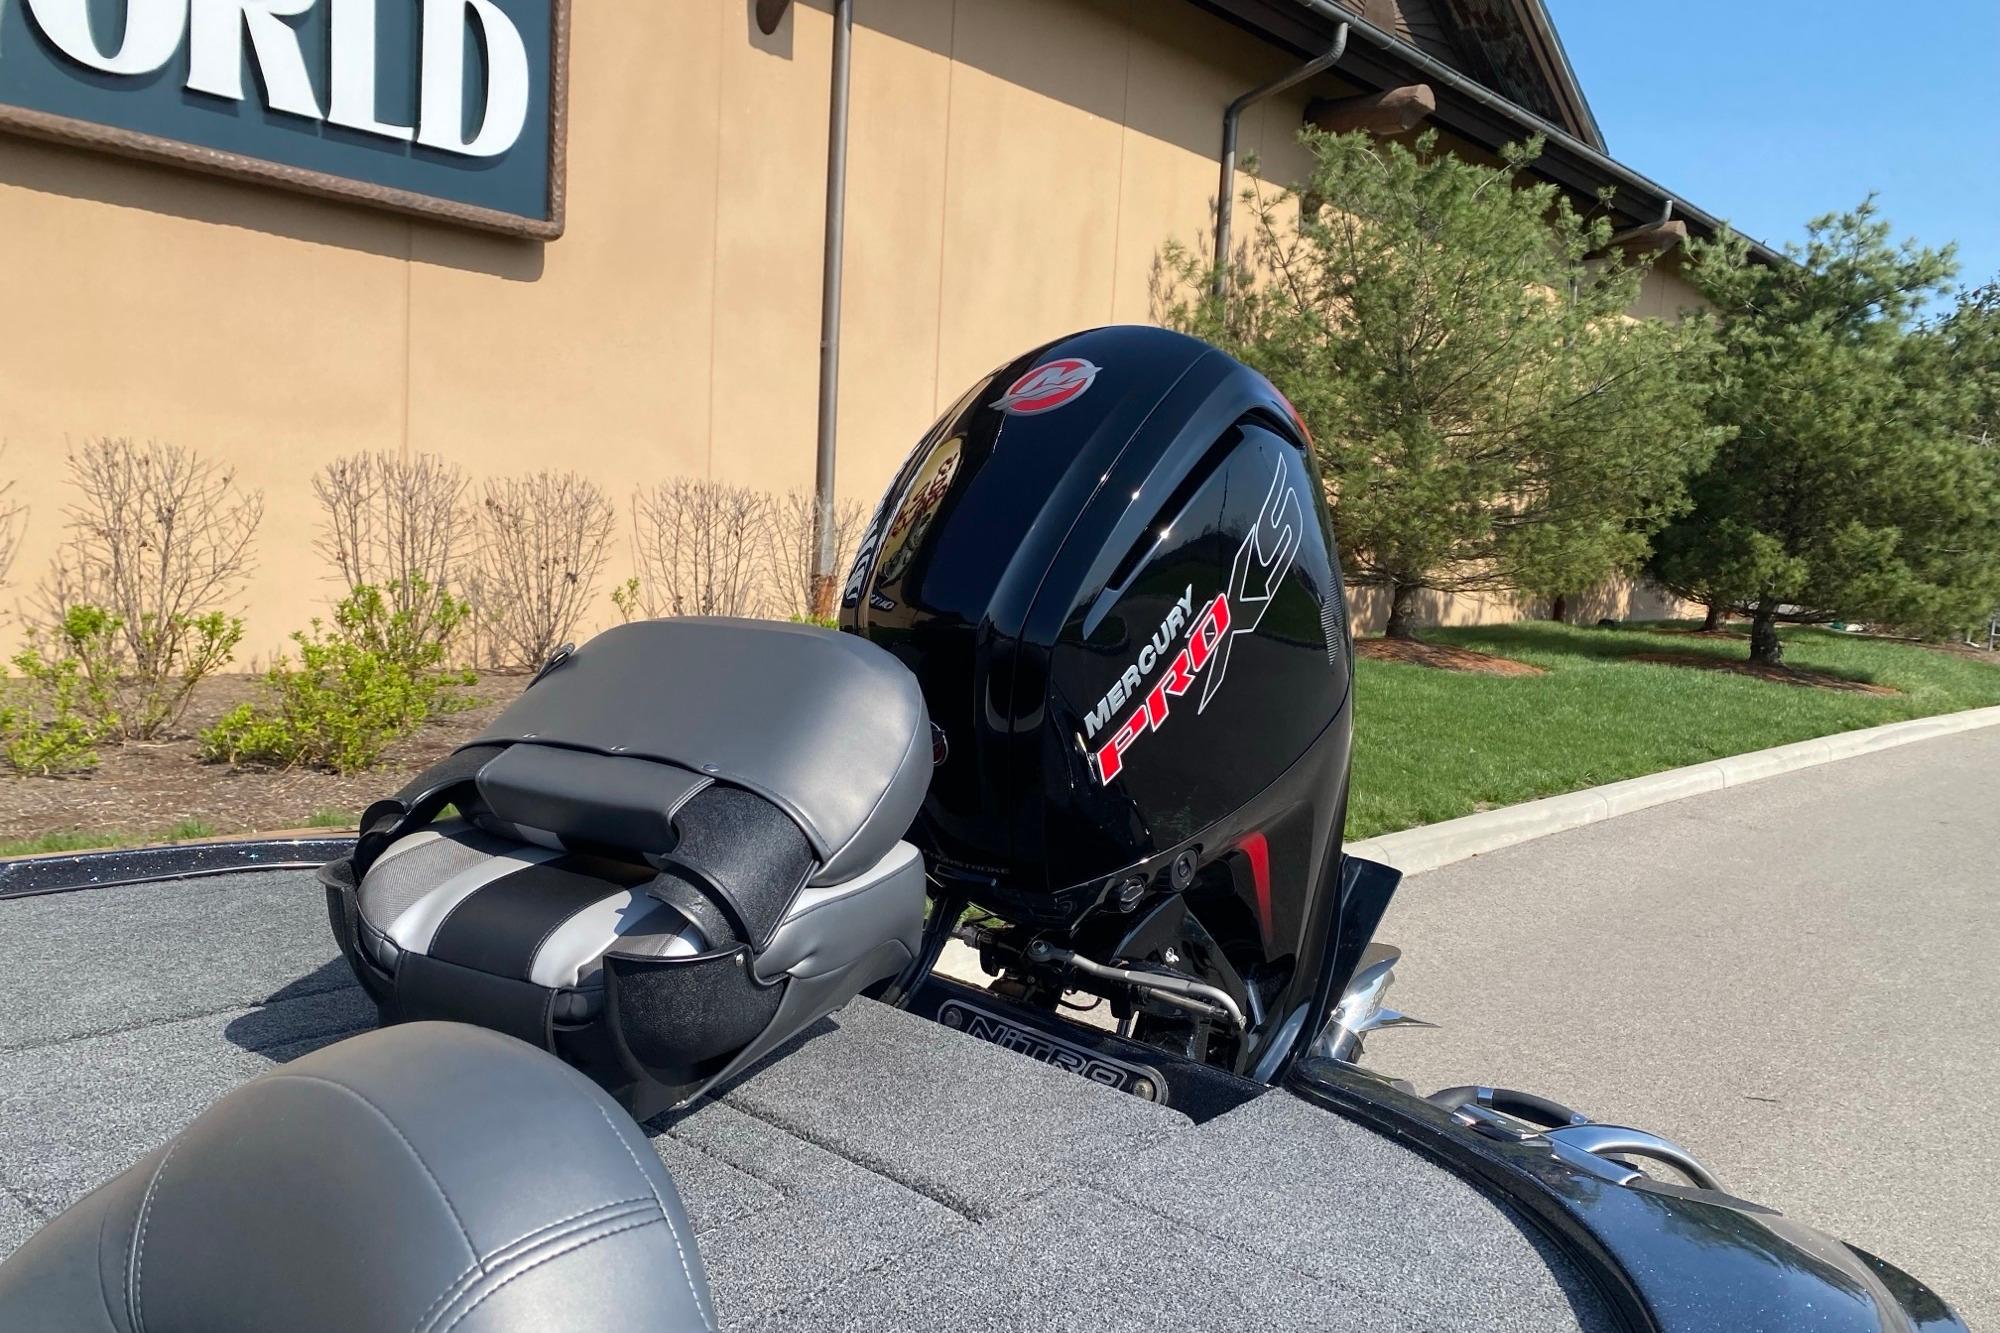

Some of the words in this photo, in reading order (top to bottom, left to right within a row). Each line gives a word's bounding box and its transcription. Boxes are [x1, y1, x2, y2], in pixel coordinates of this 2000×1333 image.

[0, 0, 529, 157] ORLD
[1084, 583, 1193, 739] MERCURY
[1096, 592, 1231, 786] PRO
[1185, 452, 1303, 715] XS
